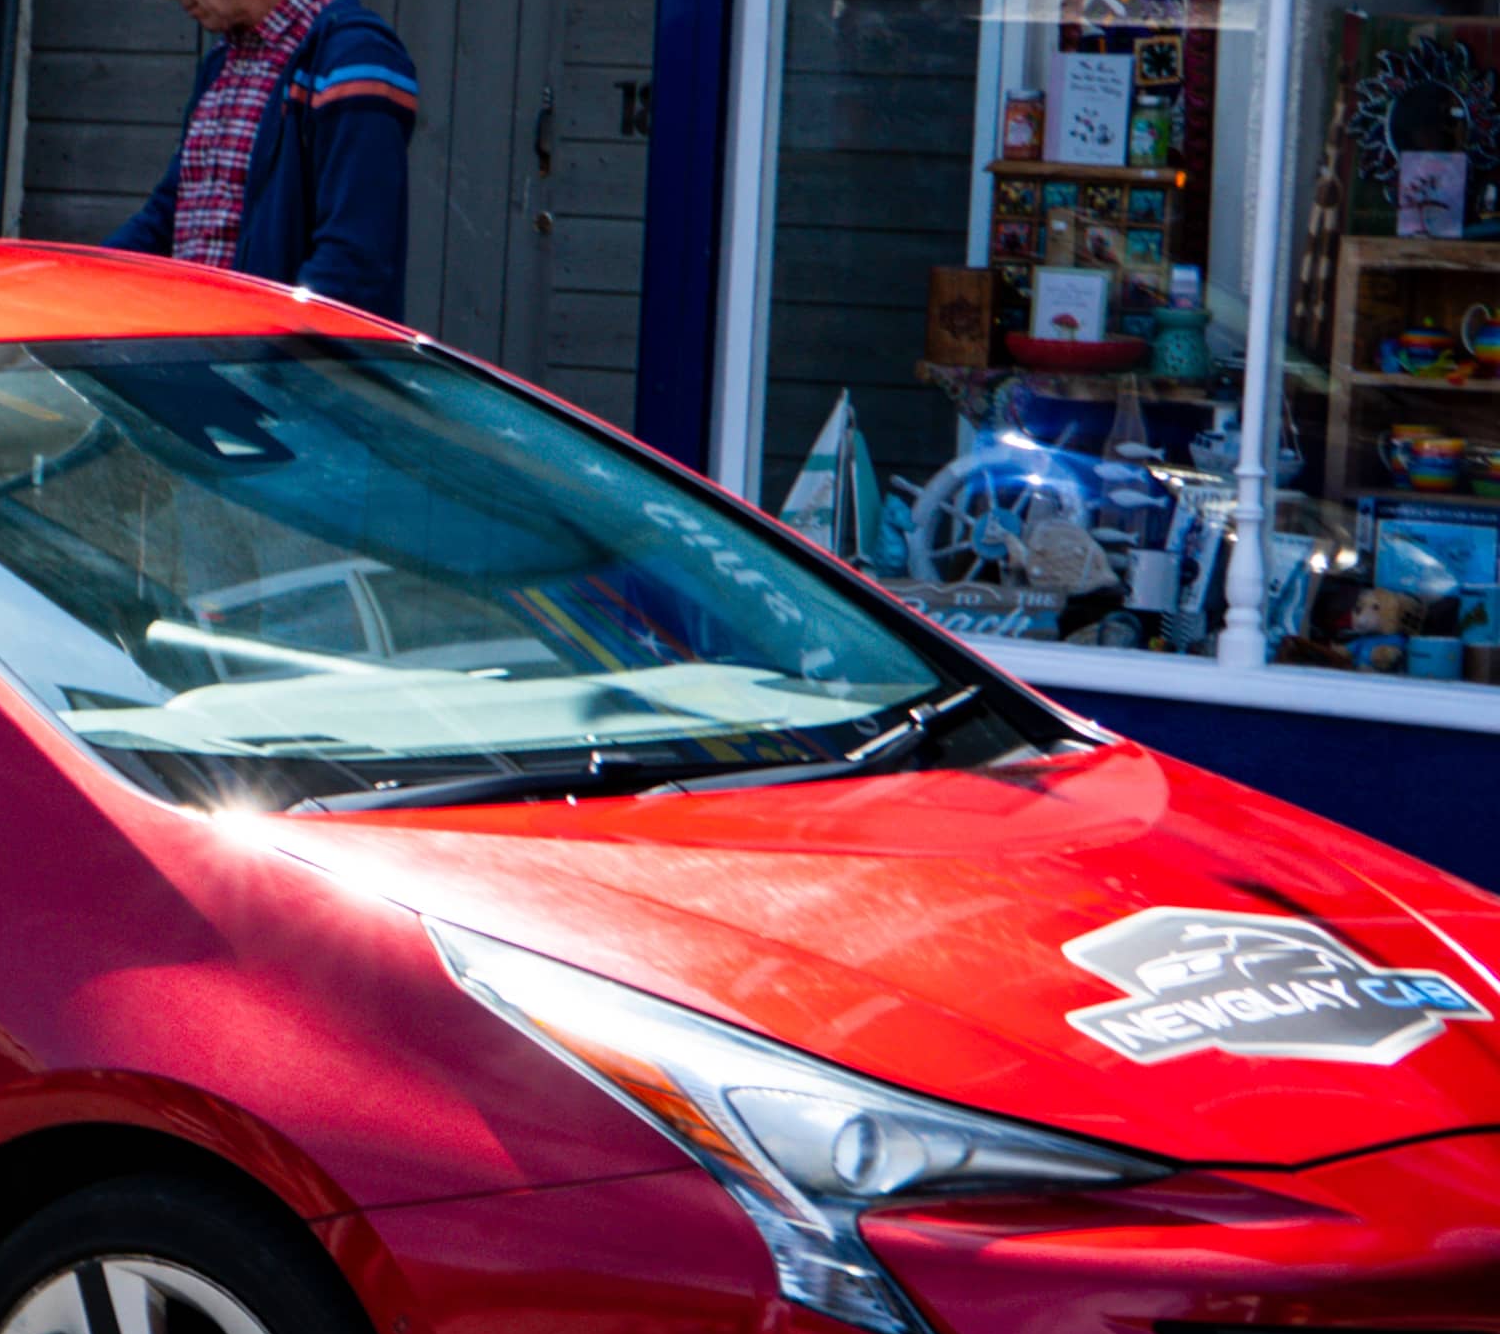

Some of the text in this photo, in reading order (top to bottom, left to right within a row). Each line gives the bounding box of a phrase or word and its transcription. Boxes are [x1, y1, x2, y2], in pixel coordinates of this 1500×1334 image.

[954, 592, 1056, 608] TO THE
[1099, 977, 1470, 1052] NEWQUAY CAB
